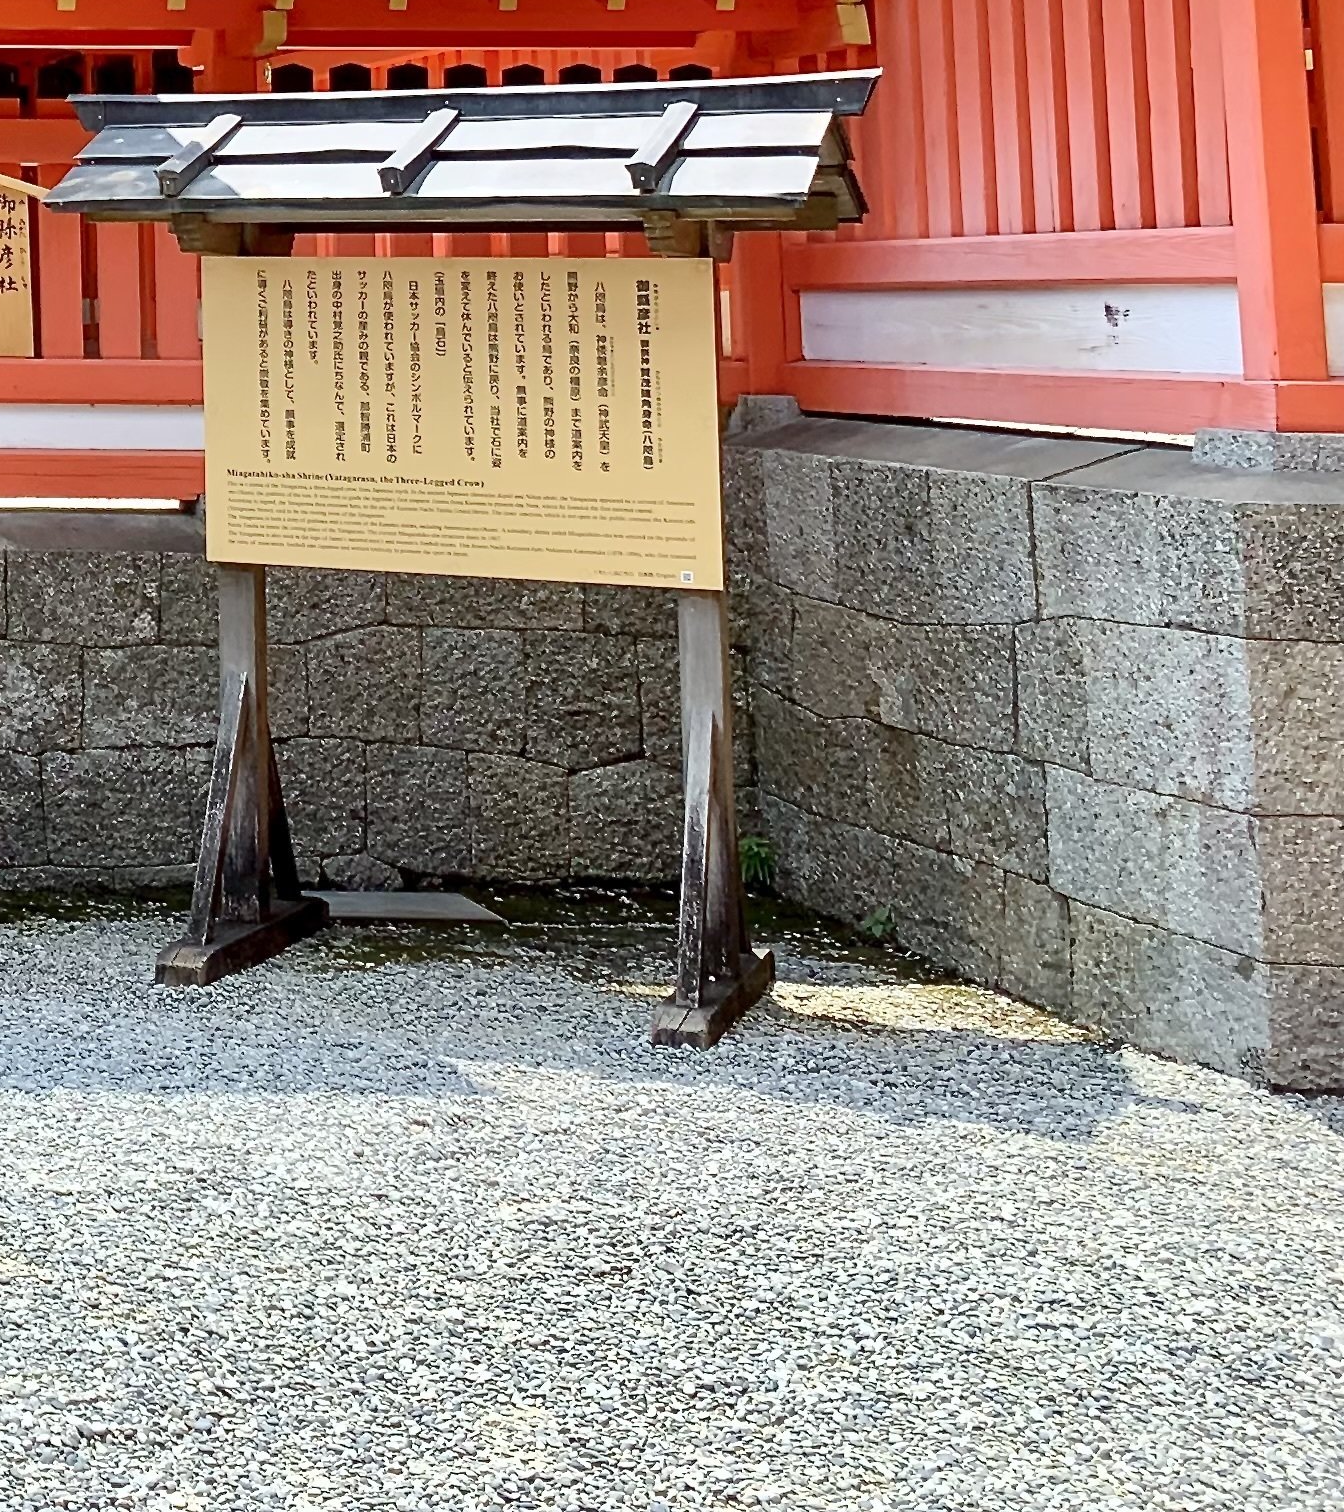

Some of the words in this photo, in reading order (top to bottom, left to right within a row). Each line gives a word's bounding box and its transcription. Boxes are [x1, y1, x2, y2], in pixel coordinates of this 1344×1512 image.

[307, 270, 318, 364] たといわれています。
[380, 476, 394, 484] the
